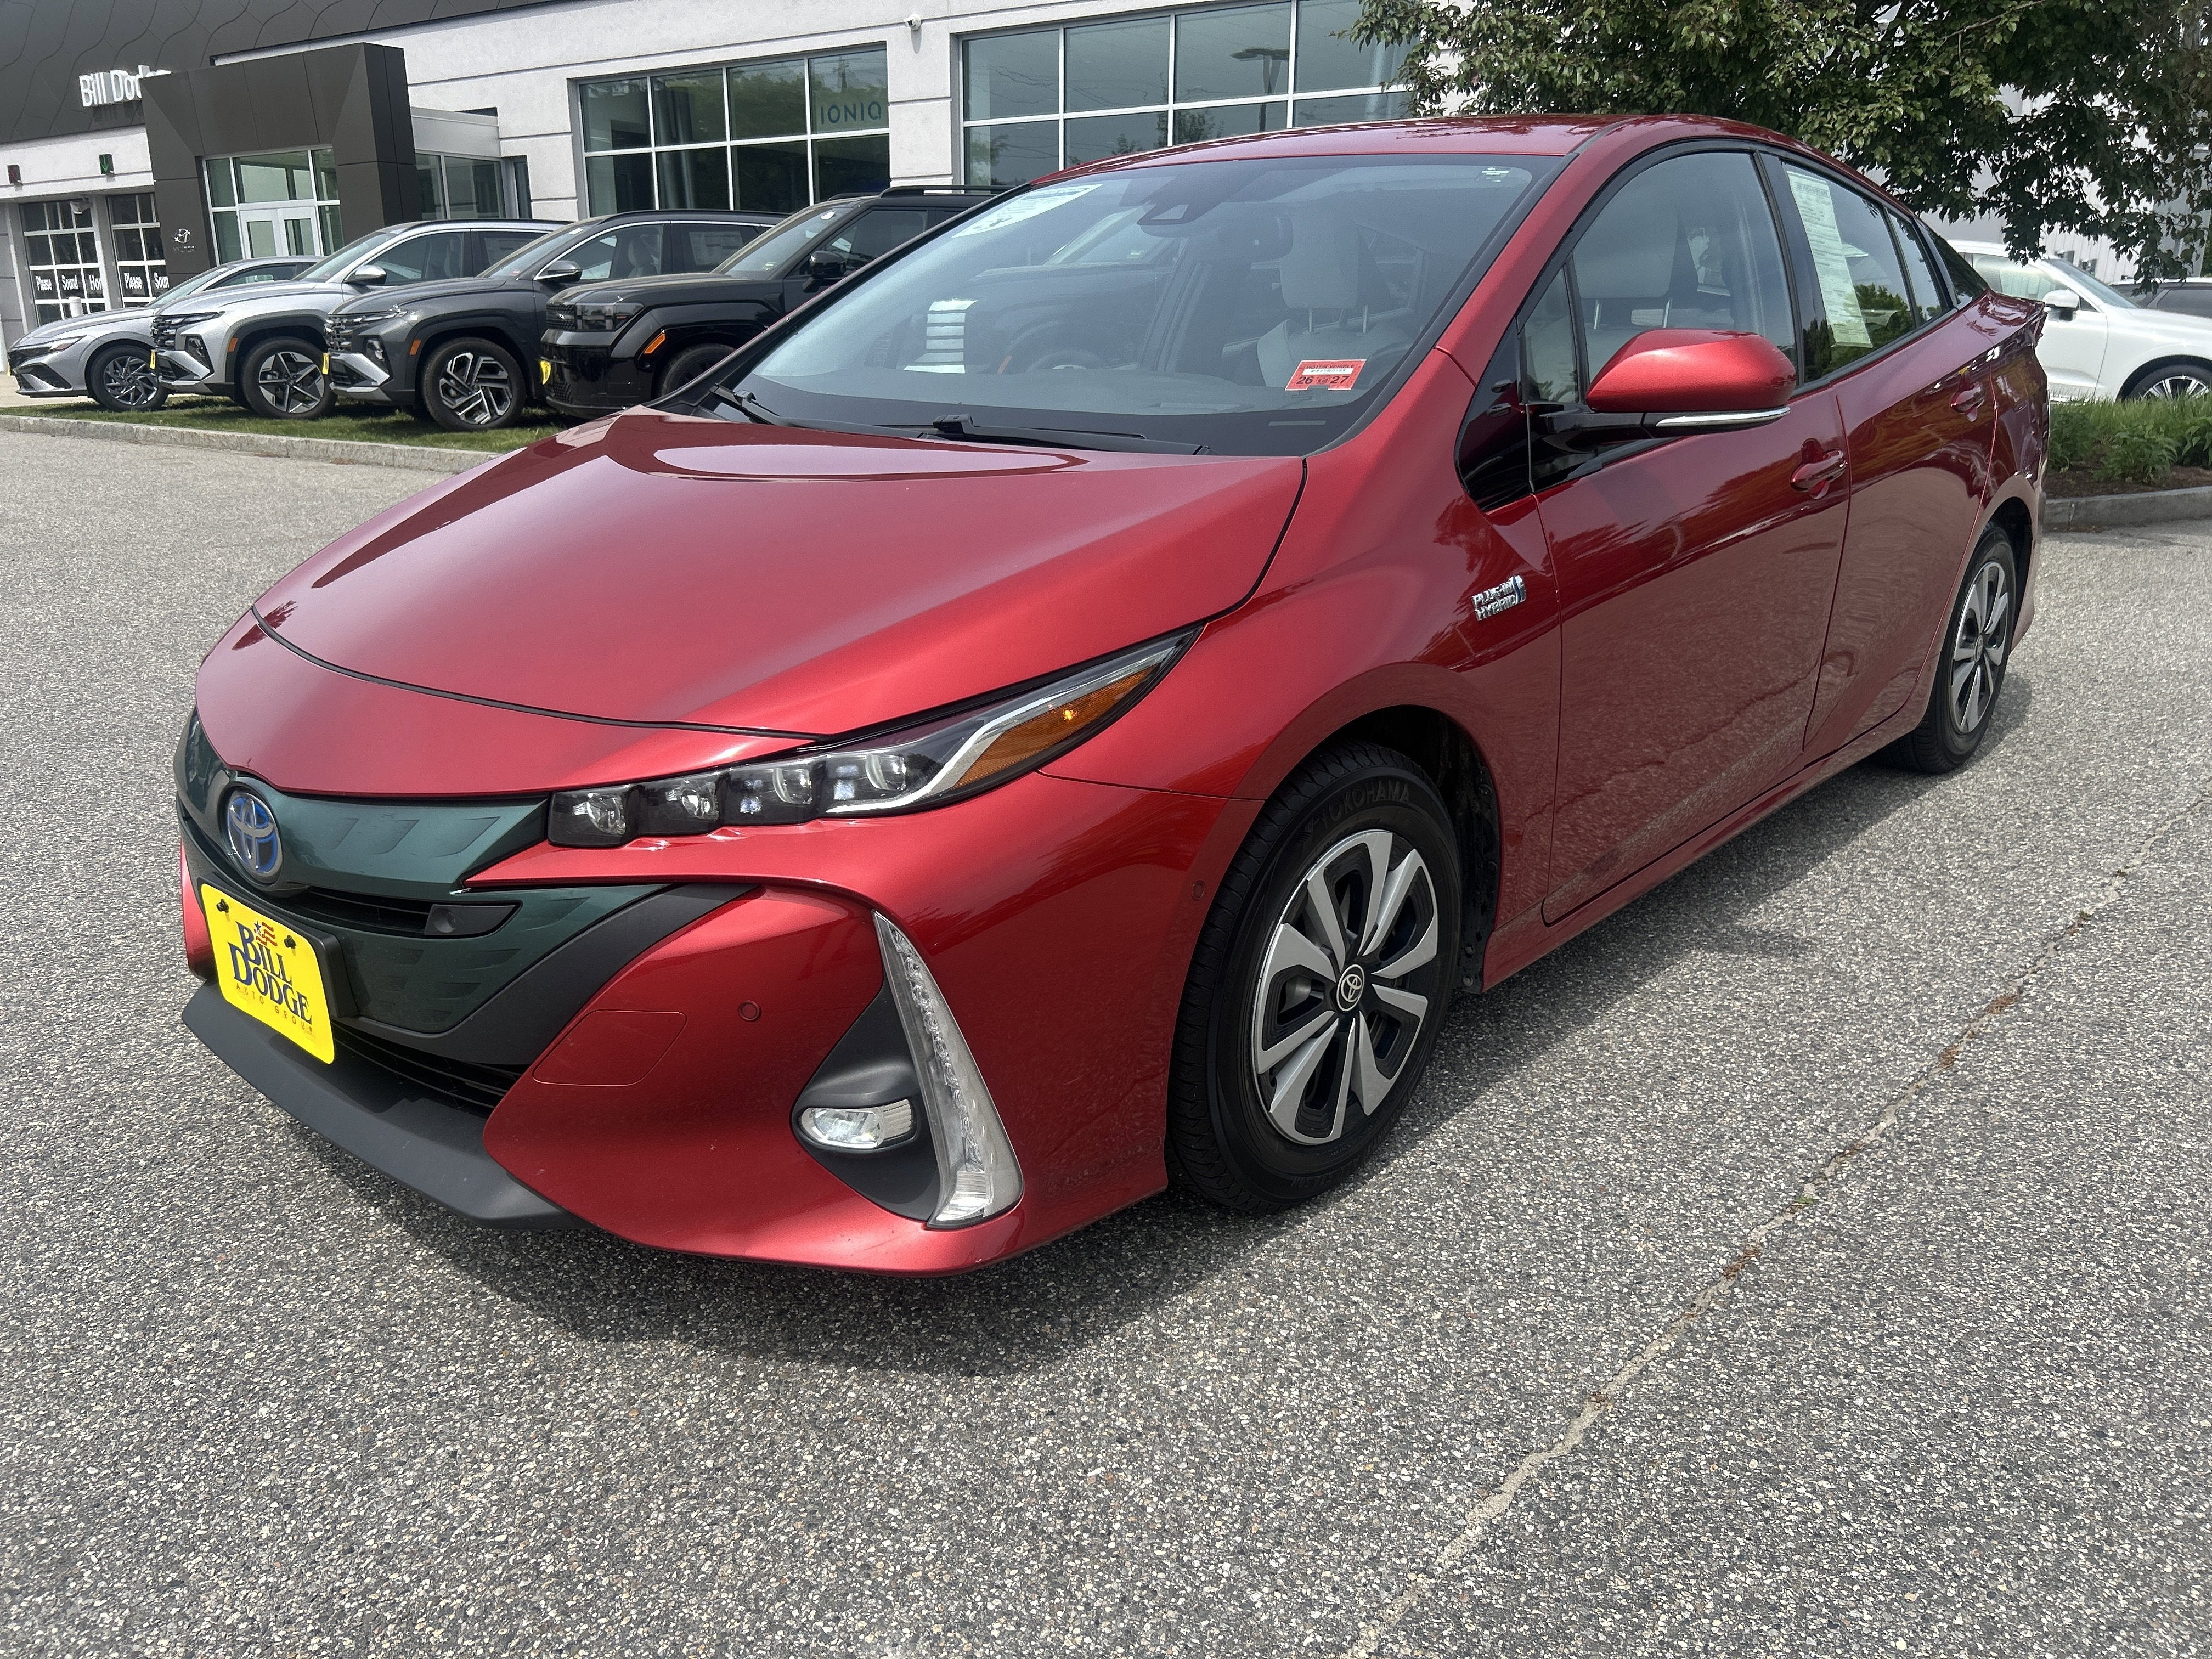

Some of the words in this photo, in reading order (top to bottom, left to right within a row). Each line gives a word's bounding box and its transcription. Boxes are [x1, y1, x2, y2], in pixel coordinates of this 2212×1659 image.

[79, 71, 108, 108] Bill
[110, 65, 172, 102] Dod
[821, 101, 882, 125] IONIQ
[36, 274, 53, 291] Please
[61, 274, 79, 291] Sound
[89, 274, 102, 290] Hor
[124, 273, 143, 289] Please
[154, 272, 170, 289] Soun
[1296, 376, 1314, 385] 26
[1330, 376, 1349, 384] 27
[1475, 594, 1517, 621] HYBRID
[1314, 780, 1410, 830] YOKOHAMA
[235, 921, 292, 986] BILL
[228, 941, 312, 1025] DODGE
[236, 983, 264, 1005] AUTO
[275, 1005, 313, 1034] GROUP
